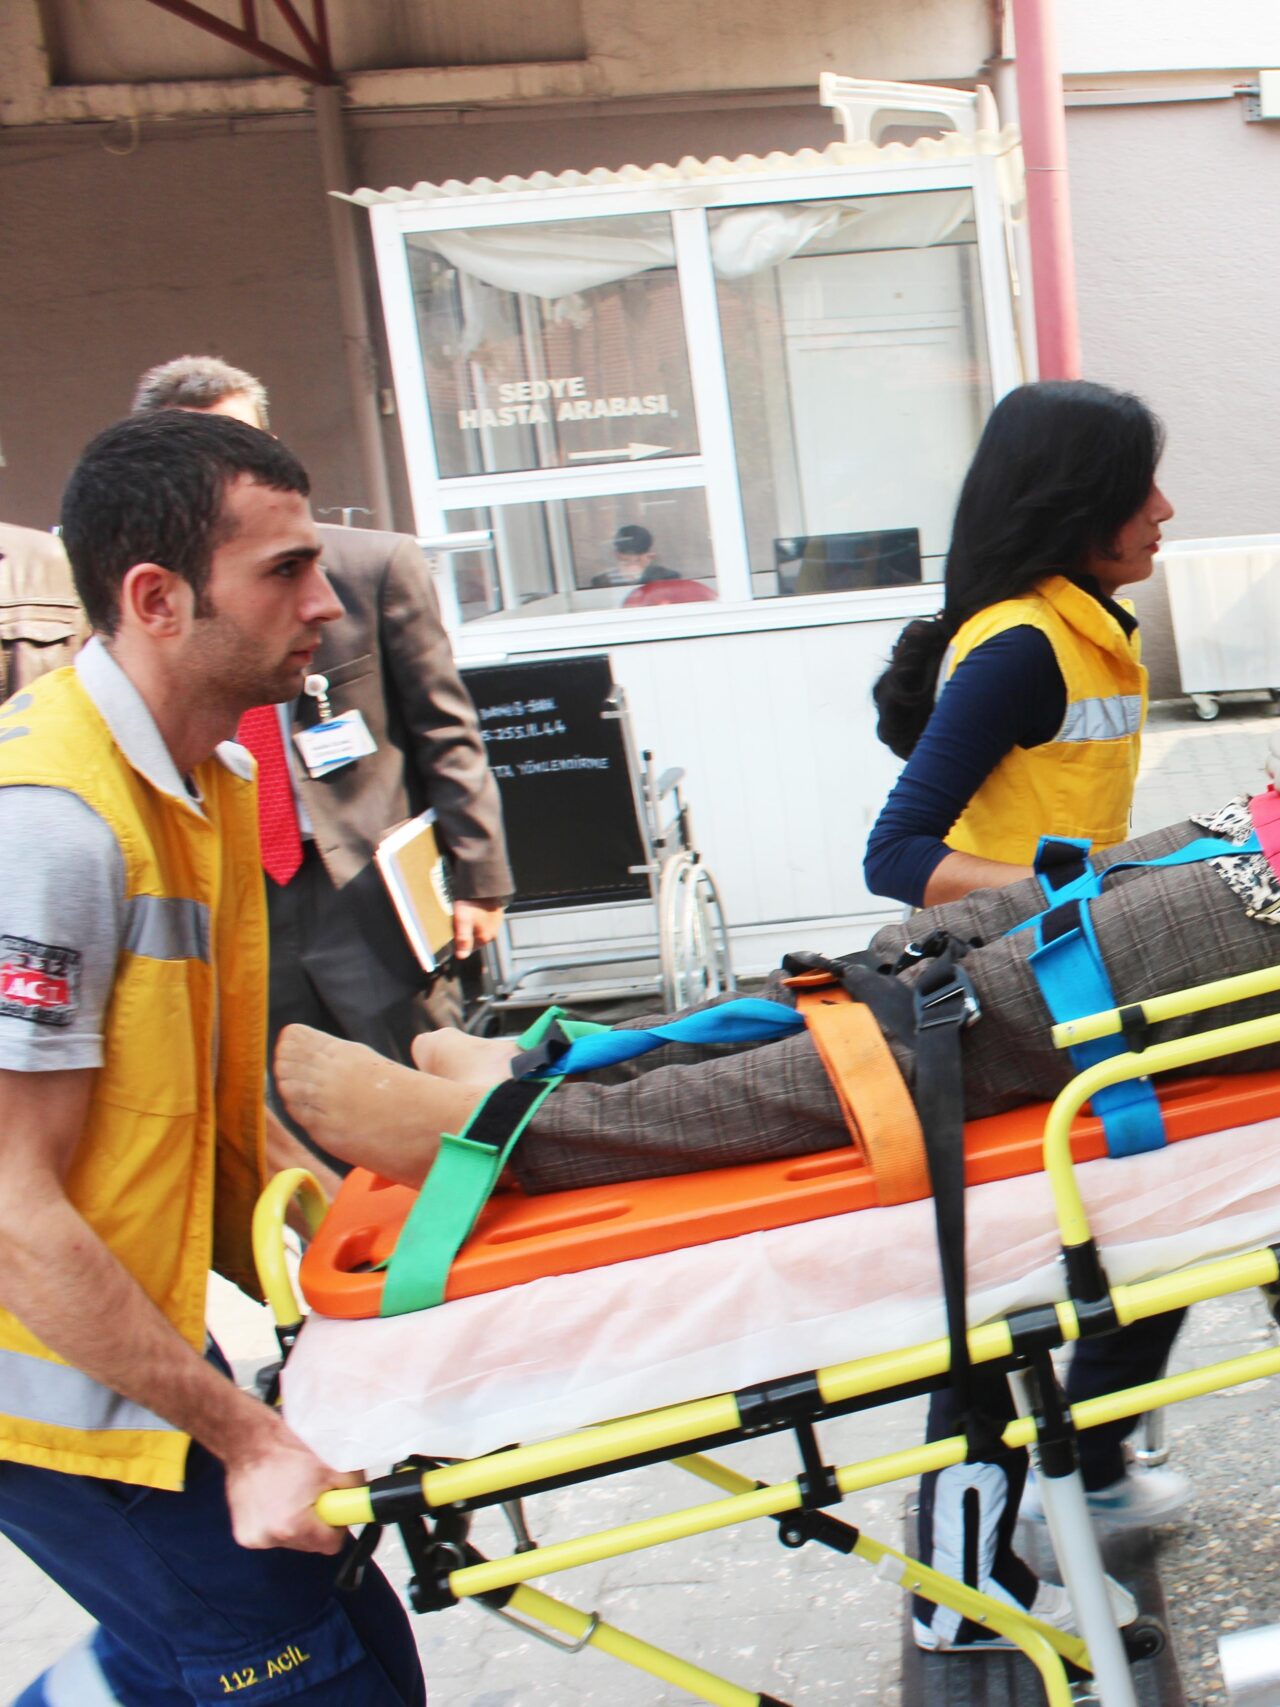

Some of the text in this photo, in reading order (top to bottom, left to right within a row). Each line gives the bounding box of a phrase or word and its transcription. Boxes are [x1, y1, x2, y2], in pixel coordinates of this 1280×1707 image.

[498, 377, 587, 402] SEDYE
[458, 395, 669, 429] HASTA ARABASI
[219, 1667, 258, 1693] 112
